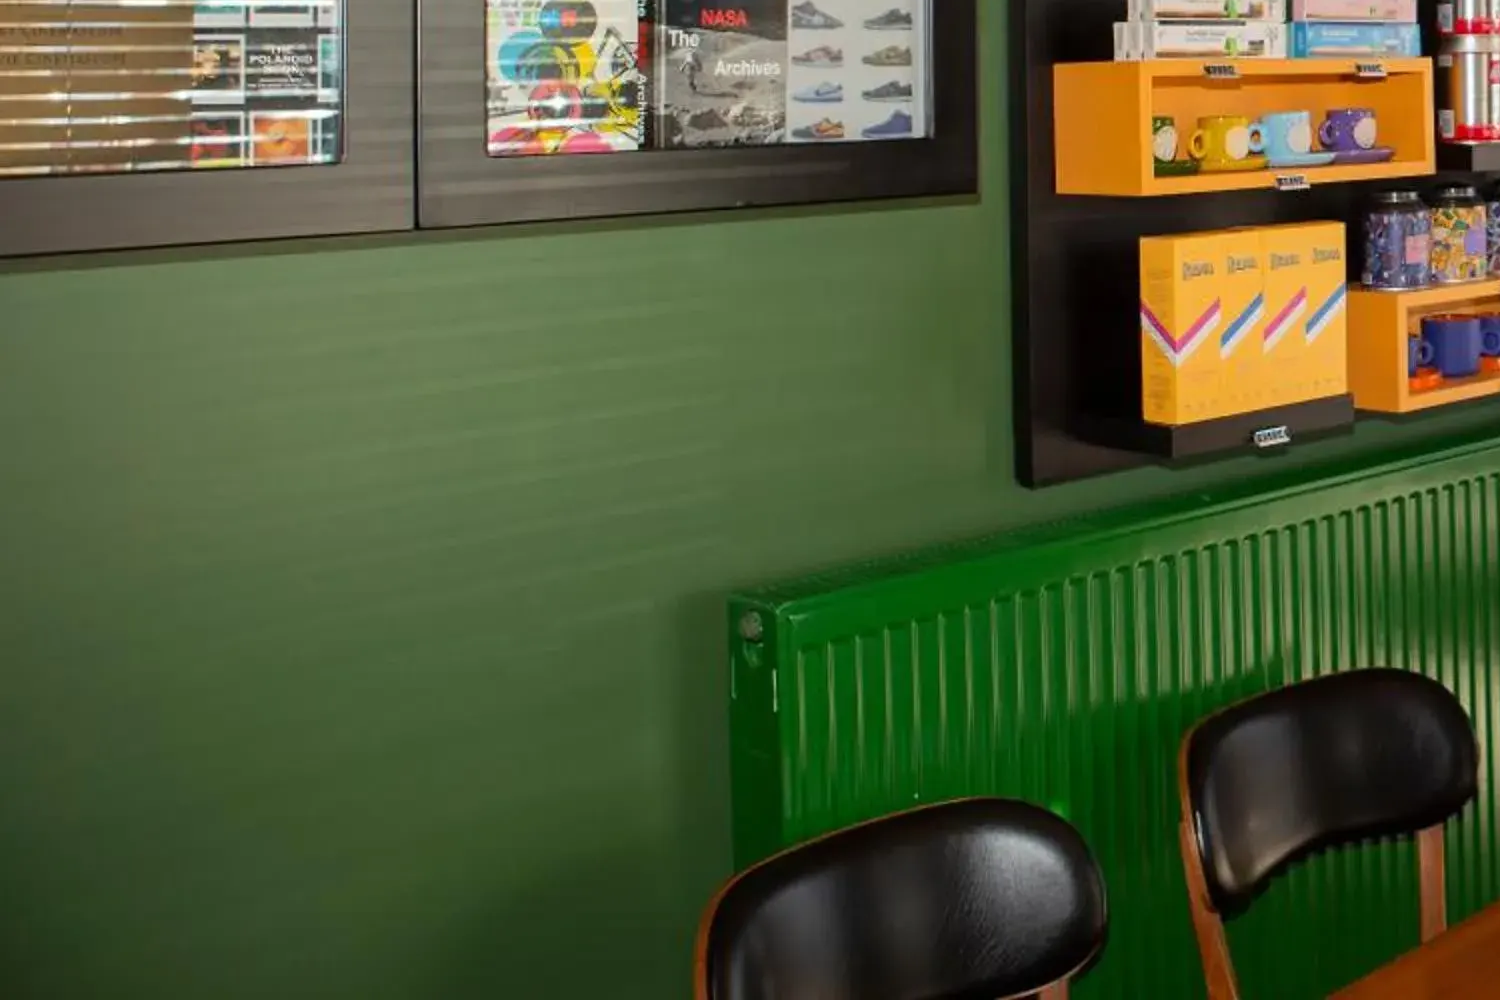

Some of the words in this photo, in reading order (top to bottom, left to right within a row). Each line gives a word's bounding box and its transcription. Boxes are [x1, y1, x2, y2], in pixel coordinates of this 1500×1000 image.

[701, 8, 747, 26] NASA
[668, 29, 700, 47] The
[715, 59, 781, 76] Archives
